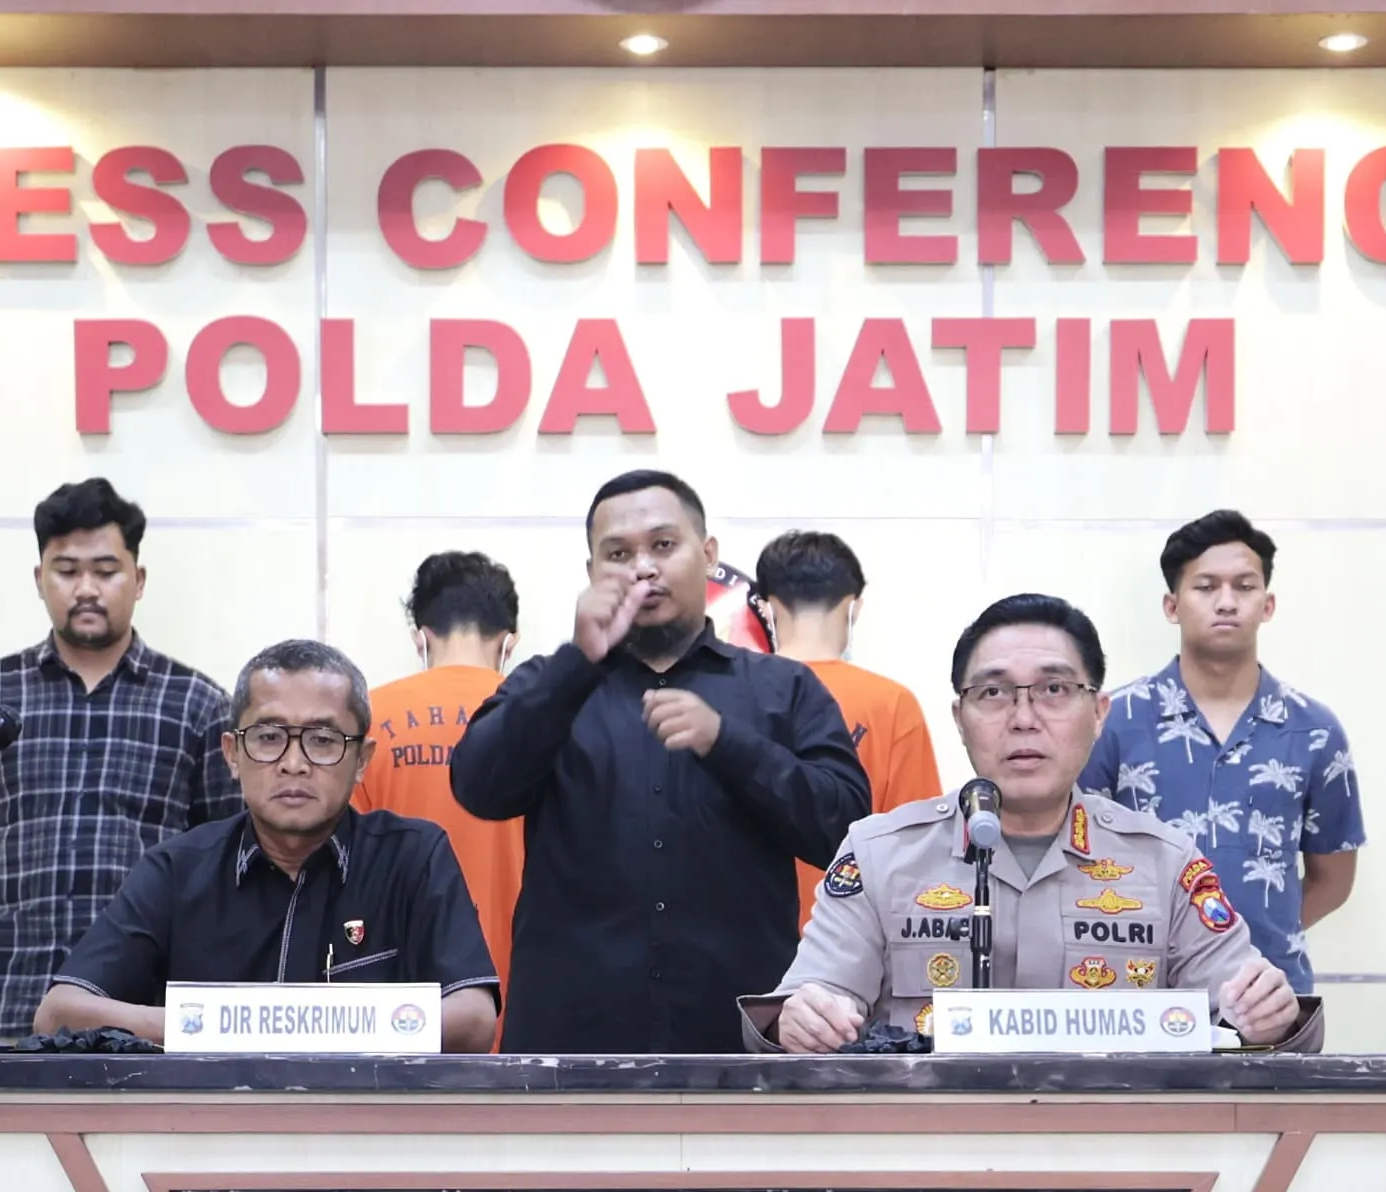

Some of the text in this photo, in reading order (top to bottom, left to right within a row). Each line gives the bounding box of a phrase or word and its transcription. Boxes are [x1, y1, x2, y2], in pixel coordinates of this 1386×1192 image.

[73, 315, 1236, 436] POLDA JATIM
[380, 705, 469, 739] TAHA
[1074, 921, 1153, 944] POLRI
[220, 1005, 376, 1034] DIR RESKRIMUM
[989, 1008, 1145, 1036] KABID HUMAS
